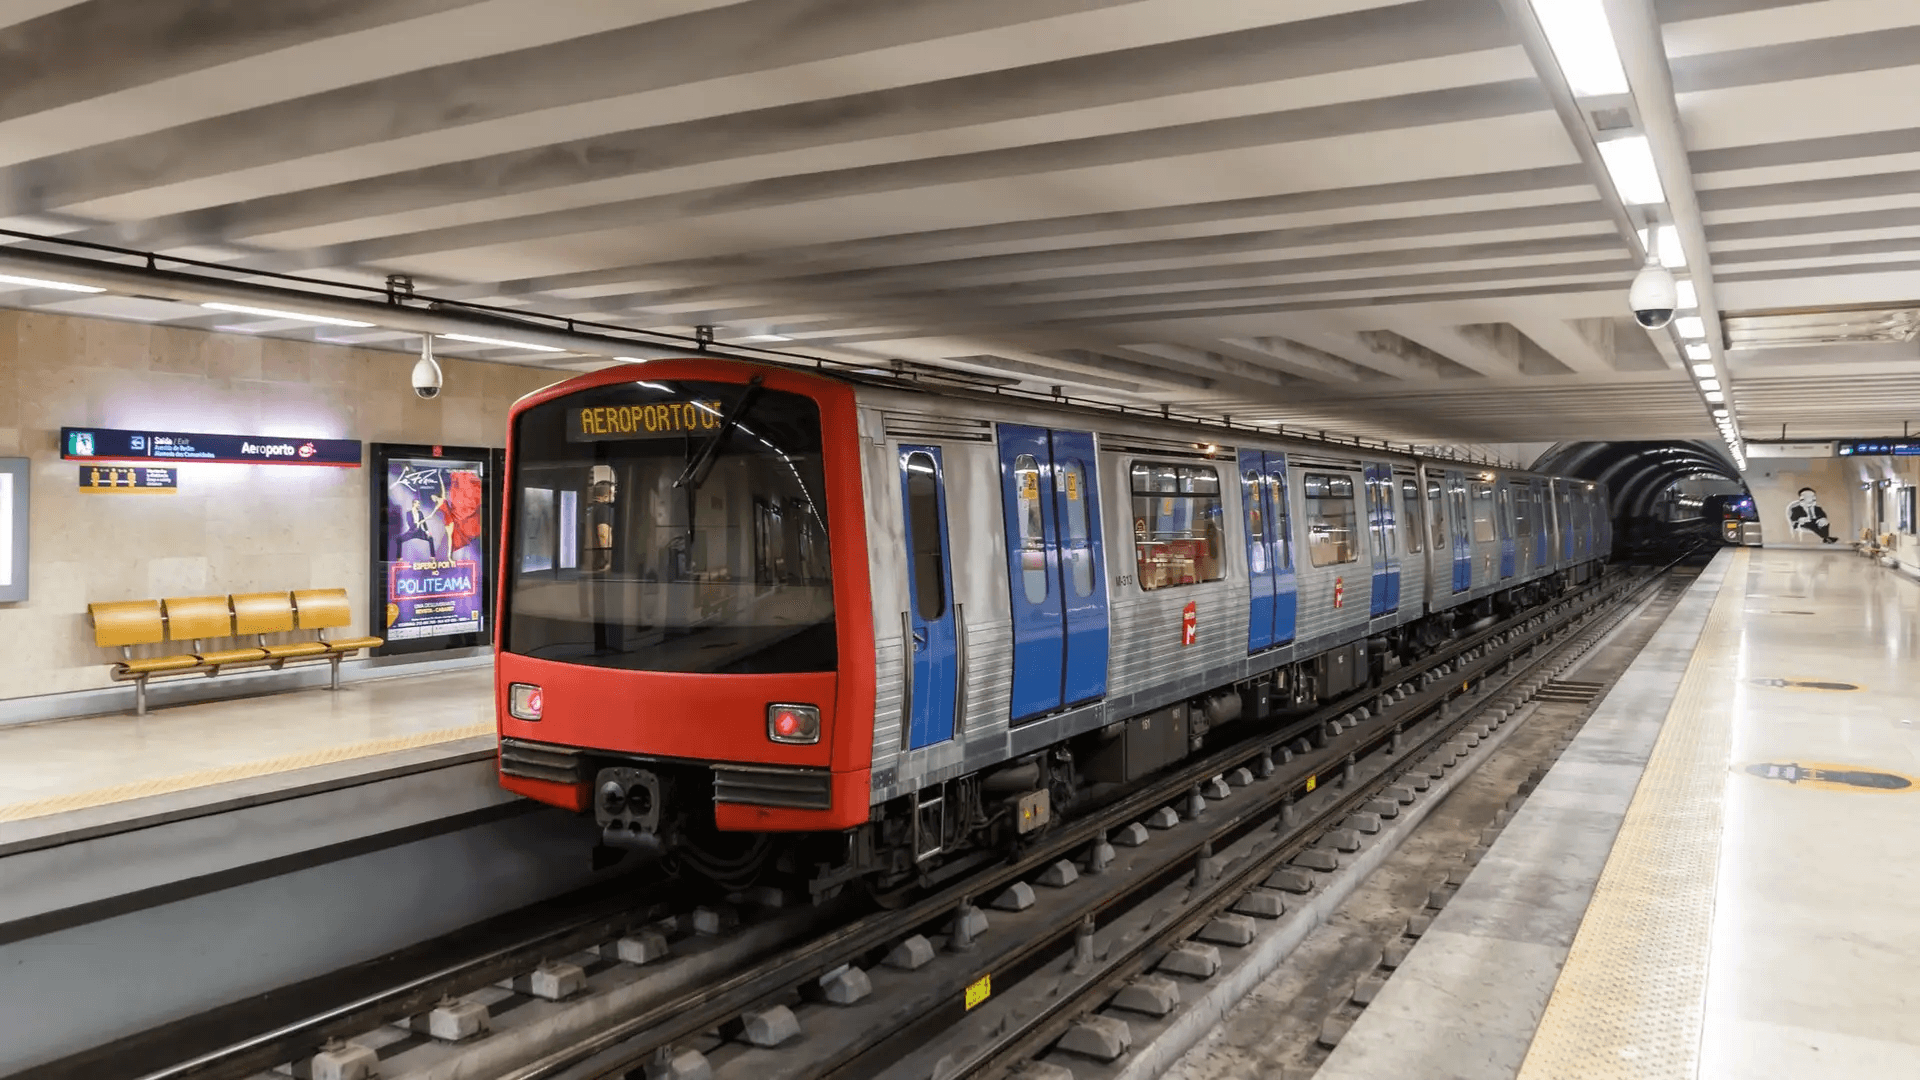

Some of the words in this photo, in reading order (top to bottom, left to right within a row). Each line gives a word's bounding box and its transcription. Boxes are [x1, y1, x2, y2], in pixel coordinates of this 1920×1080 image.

[581, 403, 697, 433] AEROPORTO
[241, 442, 296, 458] Aeroporto
[397, 576, 471, 594] POLITEAMA
[1116, 575, 1132, 586] M-313
